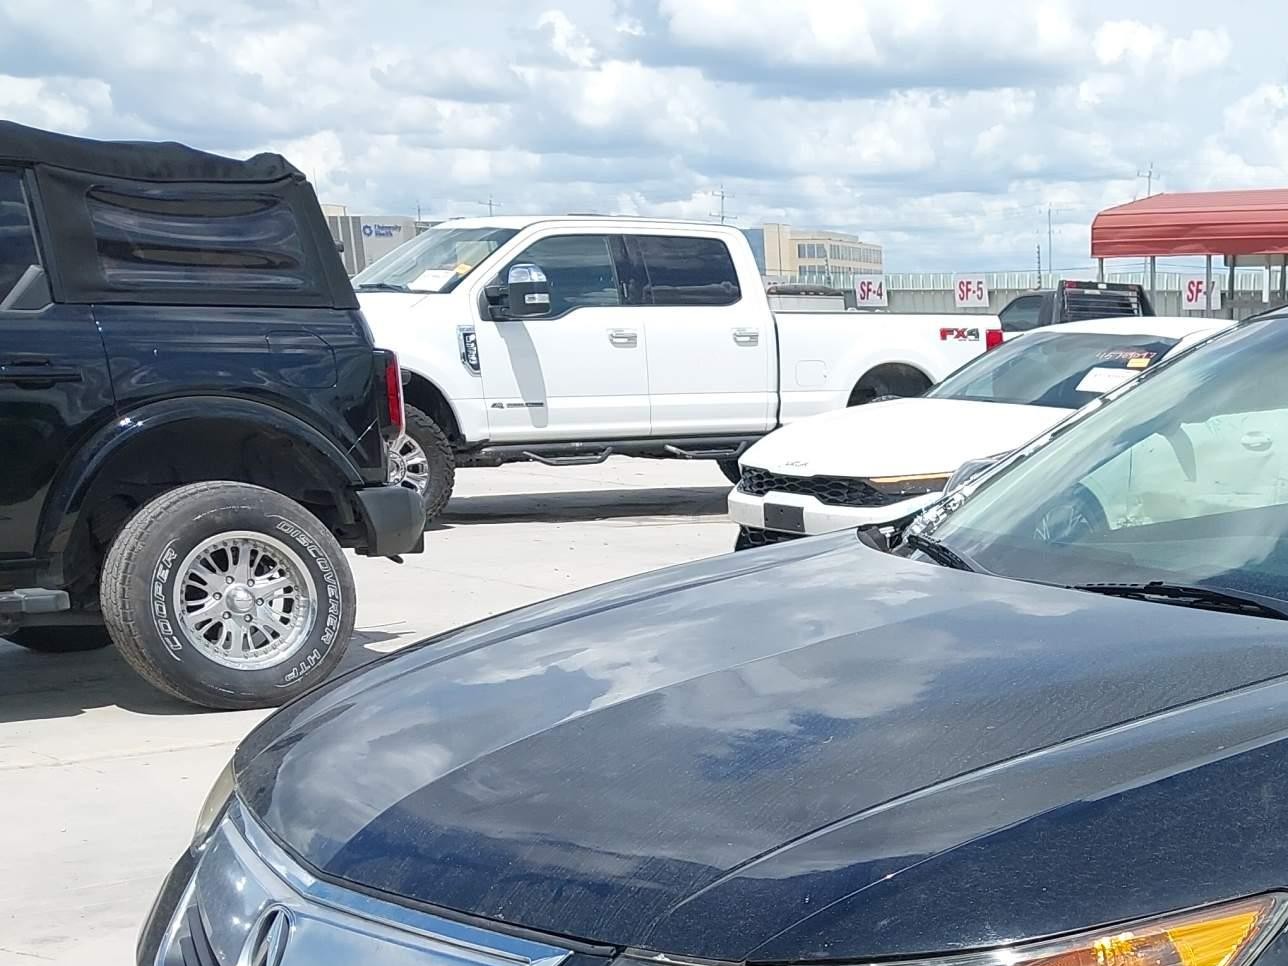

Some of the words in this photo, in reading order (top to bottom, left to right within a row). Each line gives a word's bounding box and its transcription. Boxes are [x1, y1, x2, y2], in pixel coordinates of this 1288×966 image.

[859, 280, 883, 300] SF-4
[958, 281, 984, 301] SF-5
[939, 327, 980, 341] FX4
[275, 520, 341, 646] DISCOVERER
[153, 547, 183, 651] COOPER
